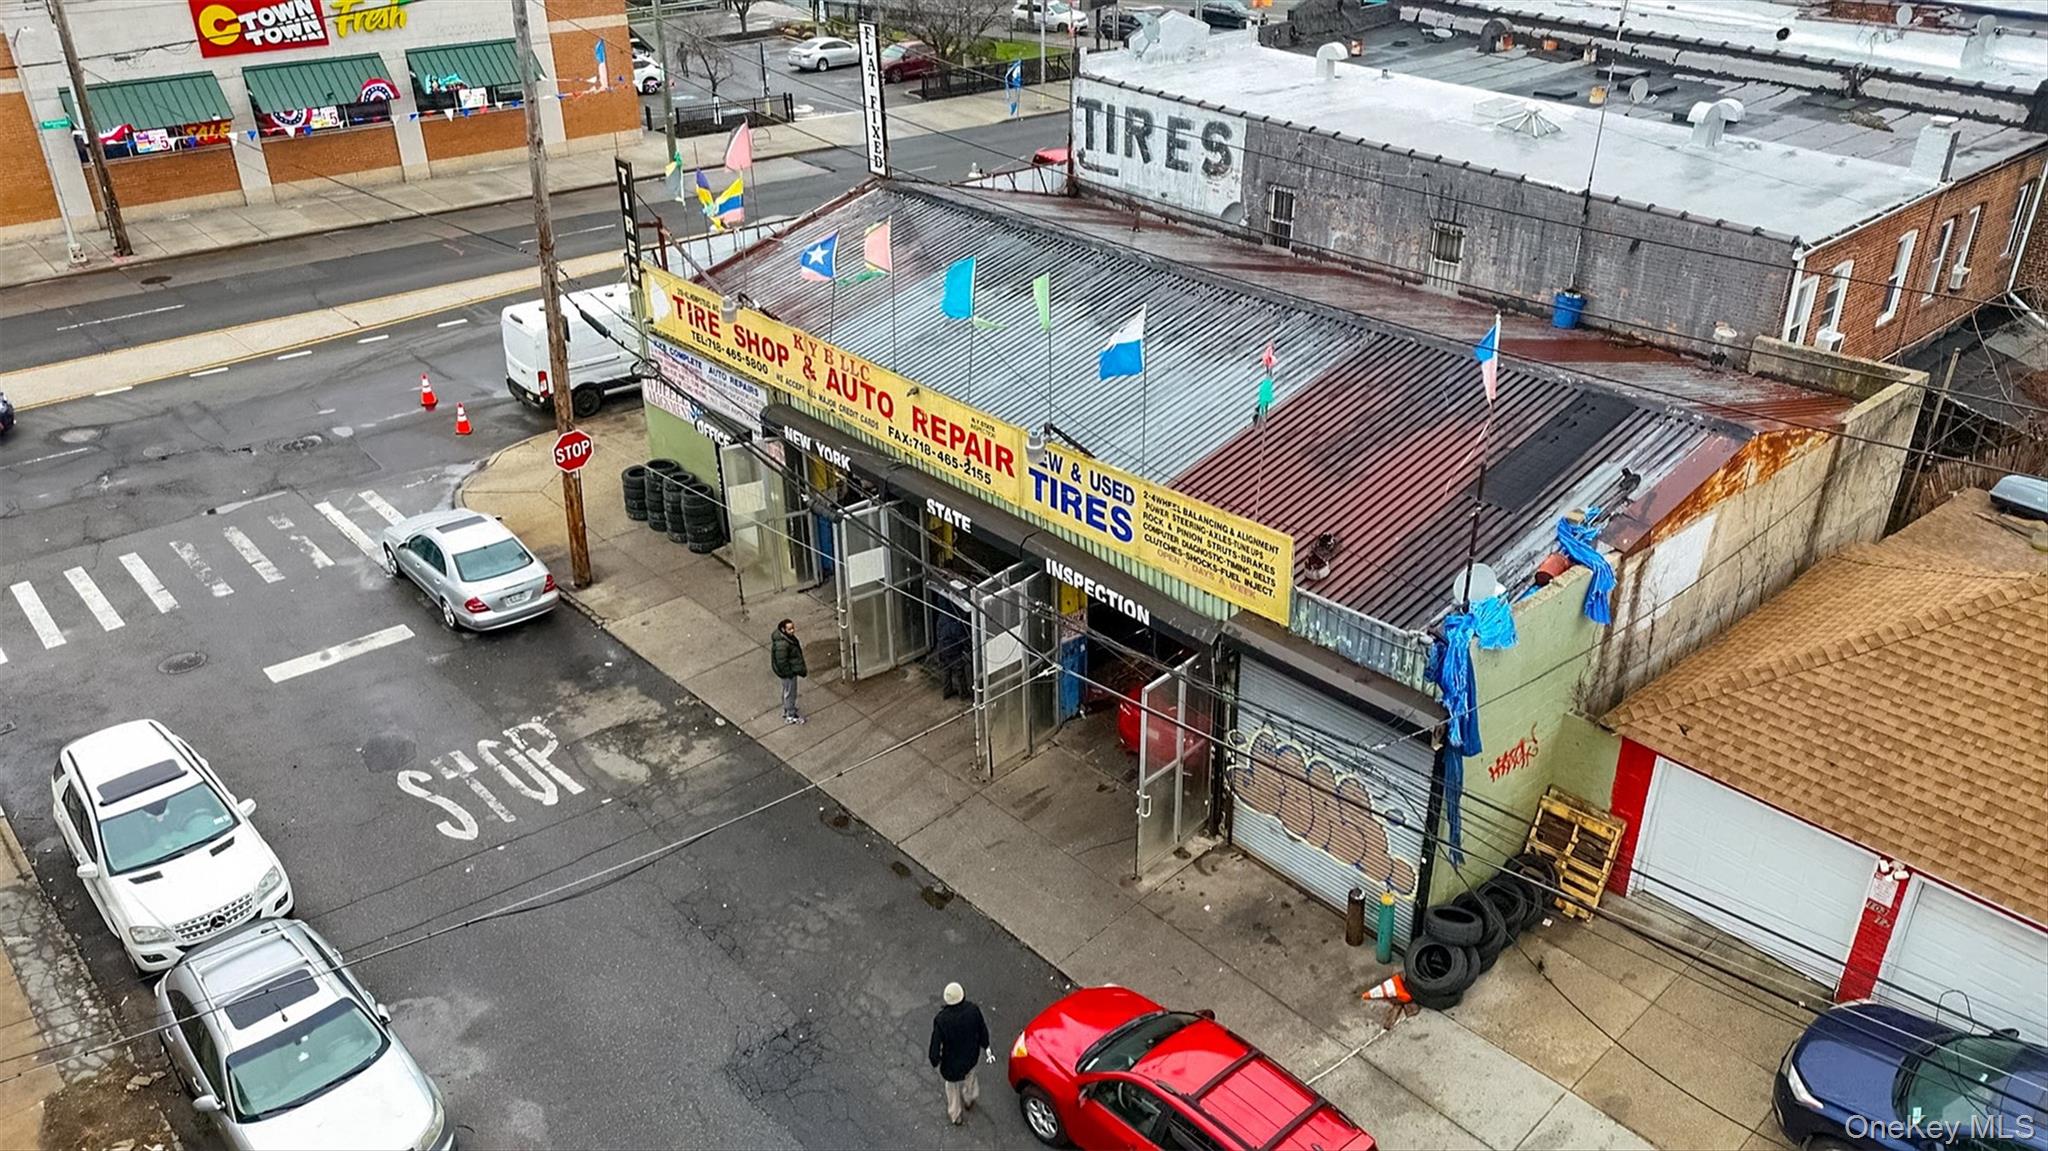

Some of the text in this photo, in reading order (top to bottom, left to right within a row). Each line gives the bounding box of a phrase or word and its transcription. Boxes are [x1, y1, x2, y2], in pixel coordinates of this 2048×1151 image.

[237, 0, 318, 31] TOWN
[244, 20, 325, 46] TOWN
[330, 0, 408, 38] Fresh
[864, 26, 883, 169] FLAT FIXED
[185, 122, 231, 141] SALE
[1077, 96, 1233, 178] TIRES
[618, 166, 640, 281] TIRES
[672, 294, 721, 339] TIRE
[733, 323, 789, 368] SHOP
[802, 355, 816, 381] &
[826, 367, 894, 418] AUTO
[912, 405, 1014, 478] REPAIR
[708, 366, 727, 381] AUTO
[730, 376, 759, 397] REPAIRS
[556, 439, 590, 463] STOP
[697, 420, 731, 446] OFFICE
[784, 425, 811, 451] NEW
[815, 441, 851, 472] YORK
[1028, 466, 1133, 543] TIRES
[1070, 462, 1082, 484] &
[1089, 470, 1135, 507] USED
[926, 498, 972, 534] STATE
[1145, 502, 1169, 518] POWER
[1182, 504, 1229, 533] BALANCING
[1237, 530, 1279, 555] ALIGNMENT
[1143, 511, 1164, 527] ROCK
[1176, 526, 1203, 544] PINION
[1206, 539, 1275, 575] STRUTS-BRAKES
[1143, 522, 1180, 545] COMPUTER
[1253, 569, 1276, 588] BELTS
[1045, 557, 1151, 627] INSPECTION
[1156, 549, 1180, 566] OPEN
[1192, 564, 1215, 581] DAYS
[1229, 578, 1256, 600] WEEK
[397, 721, 586, 840] STOP
